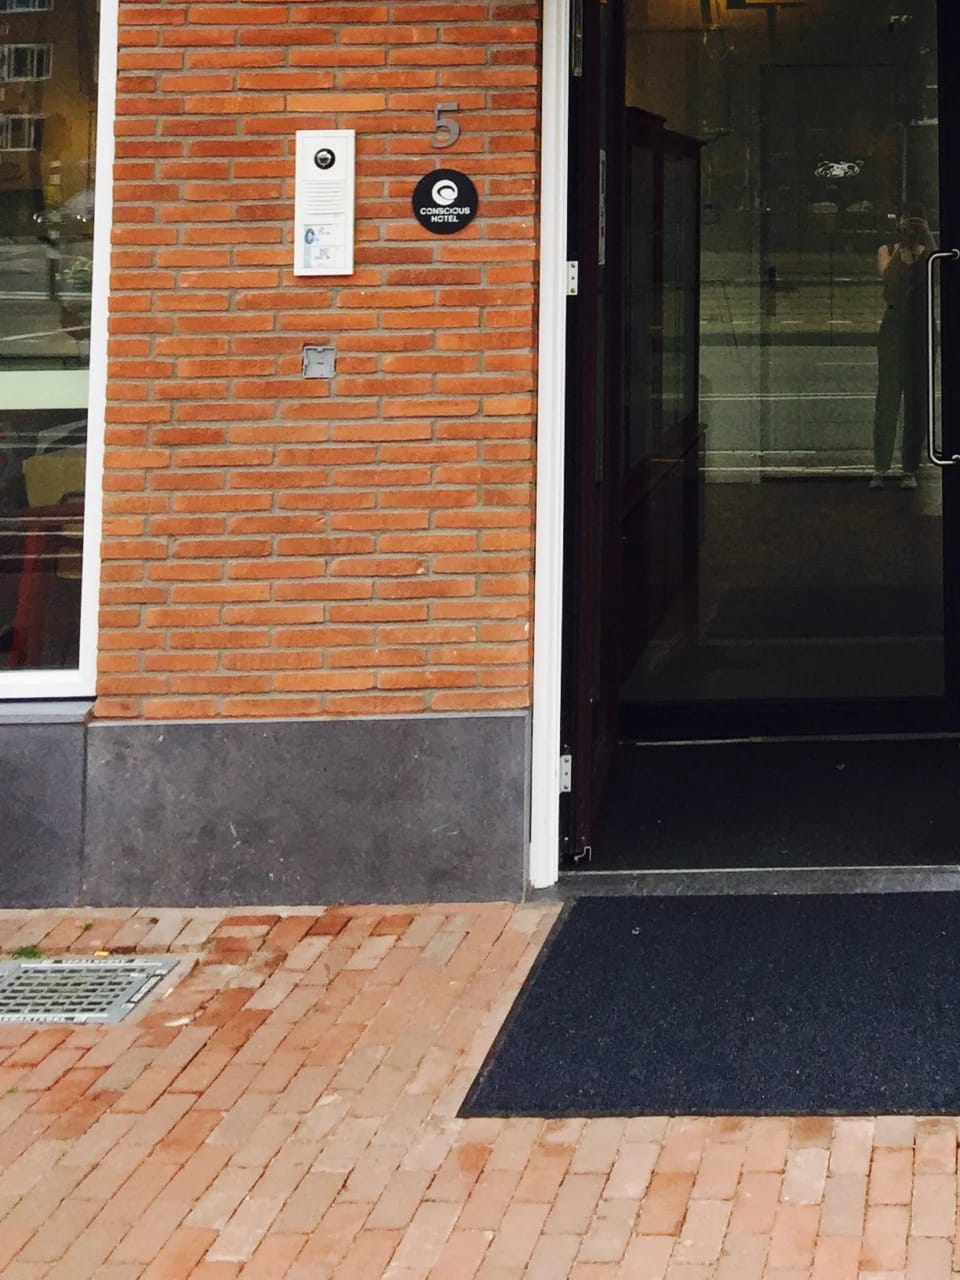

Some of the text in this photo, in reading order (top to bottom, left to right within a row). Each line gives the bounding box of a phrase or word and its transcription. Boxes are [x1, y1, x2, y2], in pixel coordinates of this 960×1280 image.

[430, 102, 460, 150] 5
[420, 207, 471, 216] CONSCIOUS
[431, 215, 459, 223] HOTEL
